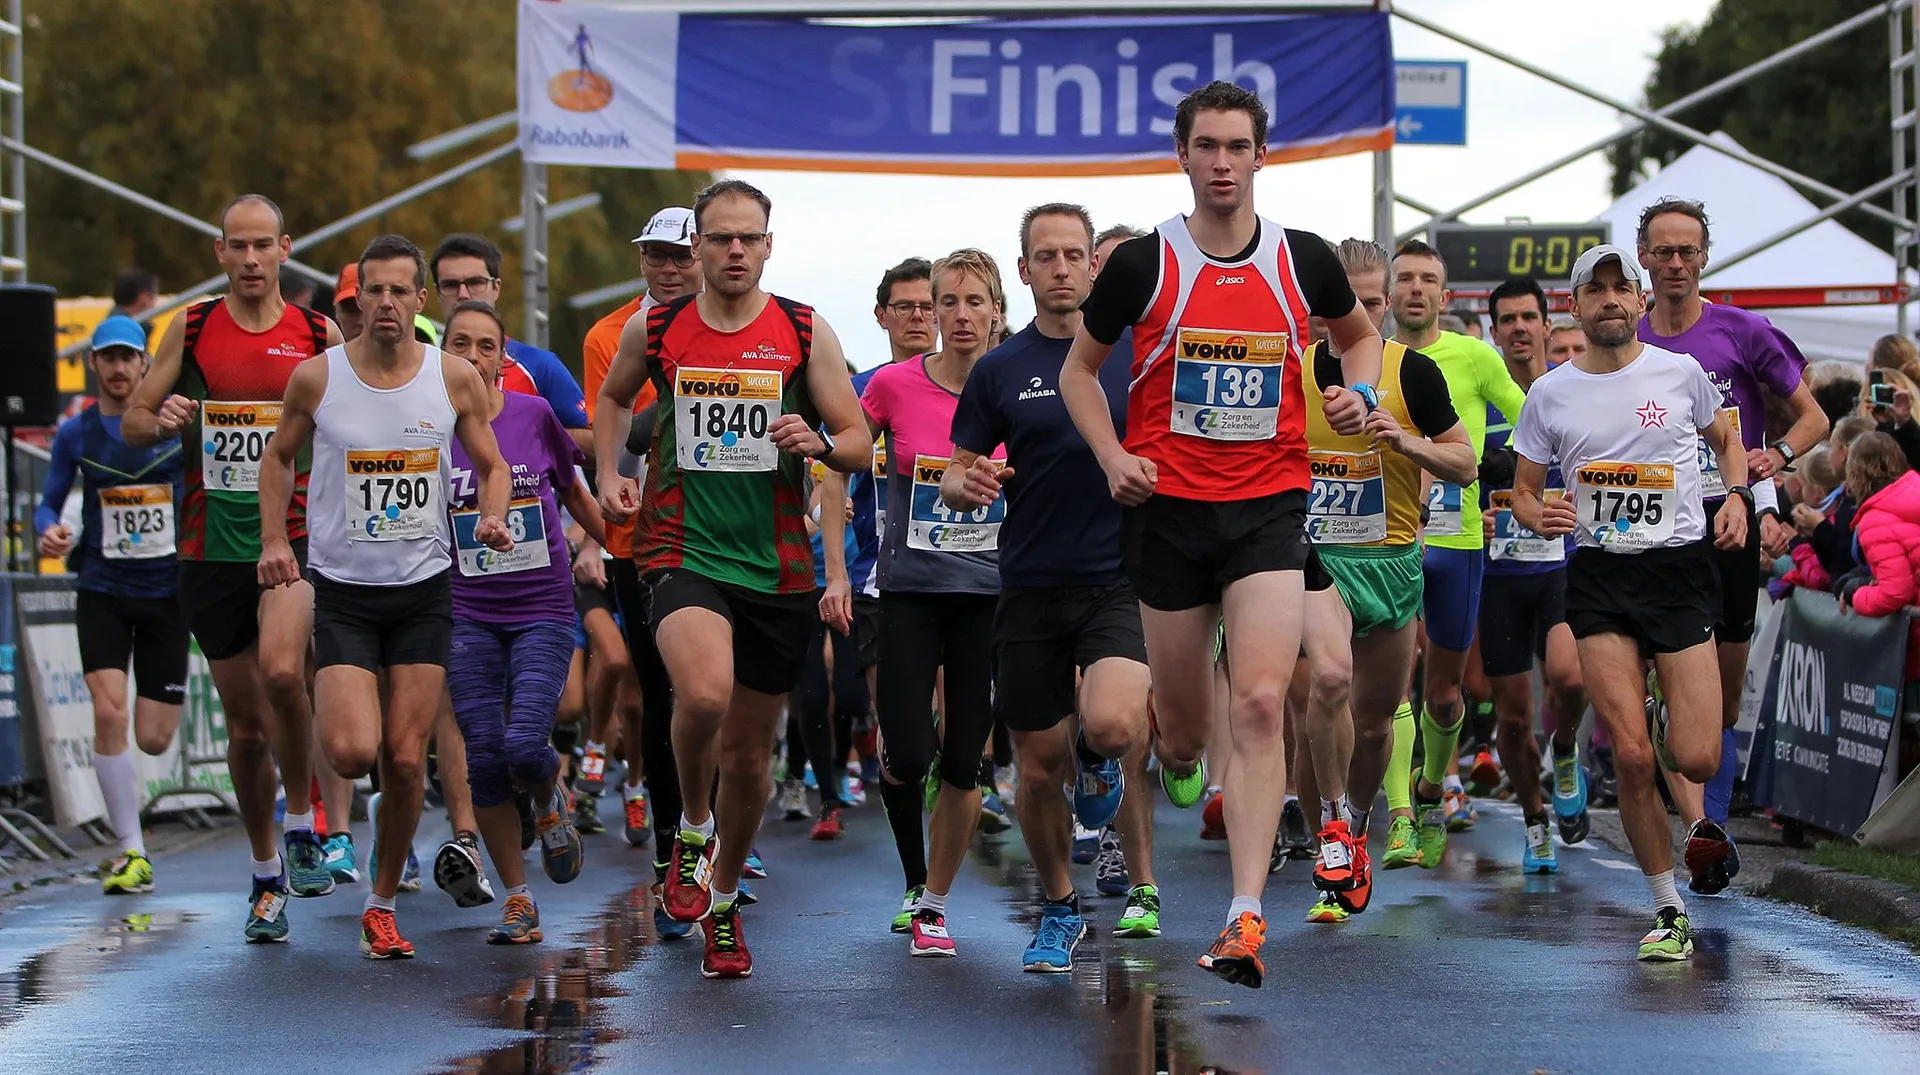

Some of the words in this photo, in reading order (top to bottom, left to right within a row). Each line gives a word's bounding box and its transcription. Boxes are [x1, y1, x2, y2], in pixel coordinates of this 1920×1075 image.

[929, 33, 1277, 137] Finish
[530, 124, 631, 149] Rabobank
[1225, 276, 1245, 284] asics
[267, 347, 281, 356] AVA
[1182, 342, 1247, 360] VOKU
[741, 351, 758, 359] AVA
[759, 351, 792, 362] Aalsmeer
[680, 380, 740, 397] VOKU
[746, 376, 773, 387] SUCCES!
[1202, 366, 1264, 407] 138
[206, 412, 256, 426] VOKU
[1178, 410, 1184, 419] 1
[1221, 412, 1242, 422] Zorg
[1648, 411, 1656, 420] H
[689, 401, 768, 439] 1840
[1221, 421, 1260, 430] Zekerheid
[403, 427, 418, 435] AVA
[681, 446, 686, 456] 1
[719, 445, 738, 454] Zorg
[719, 453, 759, 461] Zekerheid
[349, 459, 405, 473] VOKU
[512, 464, 528, 473] en
[1310, 461, 1348, 477] OKU
[208, 470, 214, 478] 1
[1580, 470, 1638, 486] VOKU
[359, 476, 430, 511] 1790
[1310, 480, 1364, 515] 227
[1591, 490, 1663, 526] 1795
[112, 508, 166, 534] 1823
[351, 519, 357, 528] 1
[389, 521, 423, 531] Zekerheid
[1331, 519, 1349, 527] Zorg
[913, 528, 919, 537] 1
[952, 528, 970, 536] Zorg
[1331, 526, 1369, 534] Zekerheid
[1616, 537, 1654, 546] Zekerheid
[463, 556, 468, 565] 1
[497, 553, 532, 564] Zekerheid
